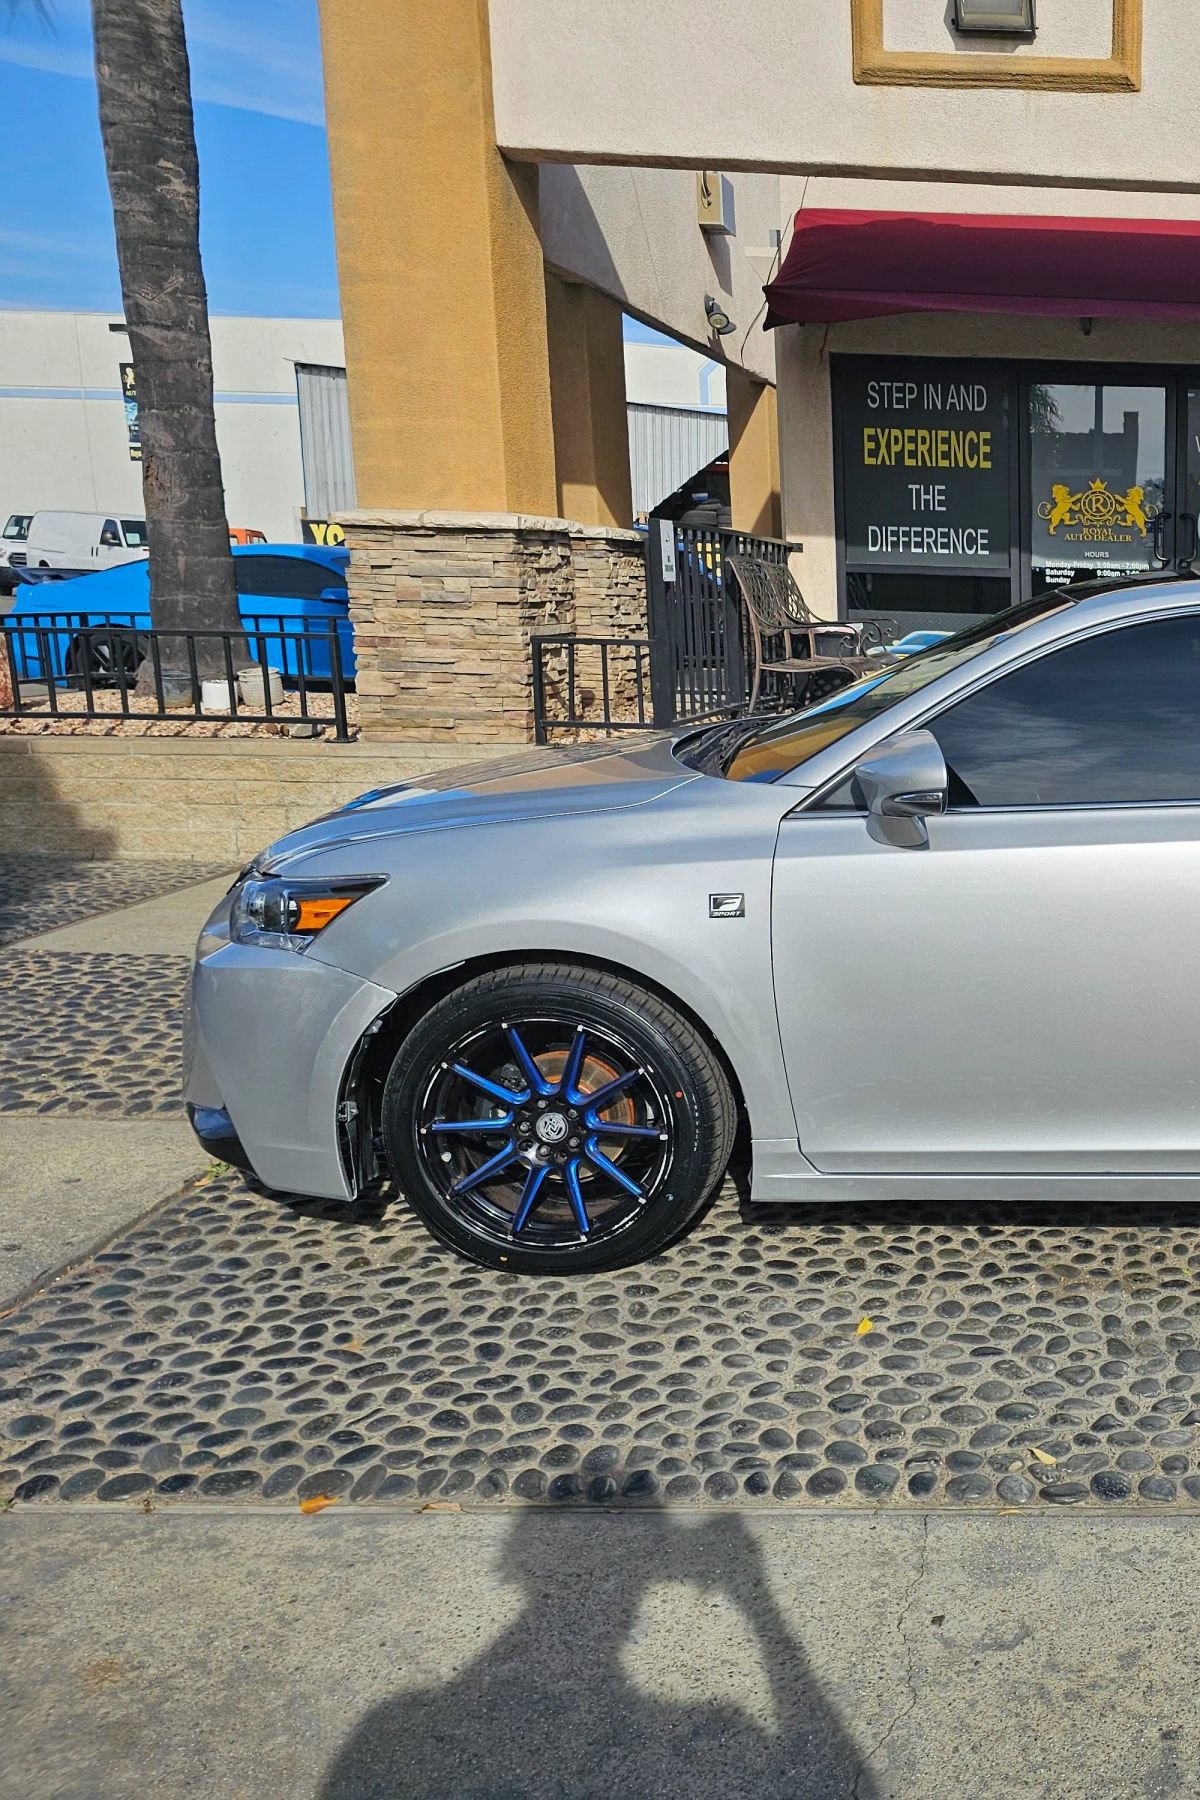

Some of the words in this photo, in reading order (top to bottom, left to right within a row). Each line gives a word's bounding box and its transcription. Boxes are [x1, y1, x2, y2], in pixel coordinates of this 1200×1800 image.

[867, 381, 918, 409] STEP
[923, 383, 942, 410] IN
[945, 384, 988, 412] AND
[863, 427, 992, 469] EXPERIENCE
[907, 484, 947, 511] THE
[868, 525, 990, 555] DIFFERENCE
[1064, 533, 1092, 541] AUTO
[1093, 534, 1132, 542] DEALER
[1045, 568, 1075, 577] Saturday
[1045, 576, 1071, 584] Sunday
